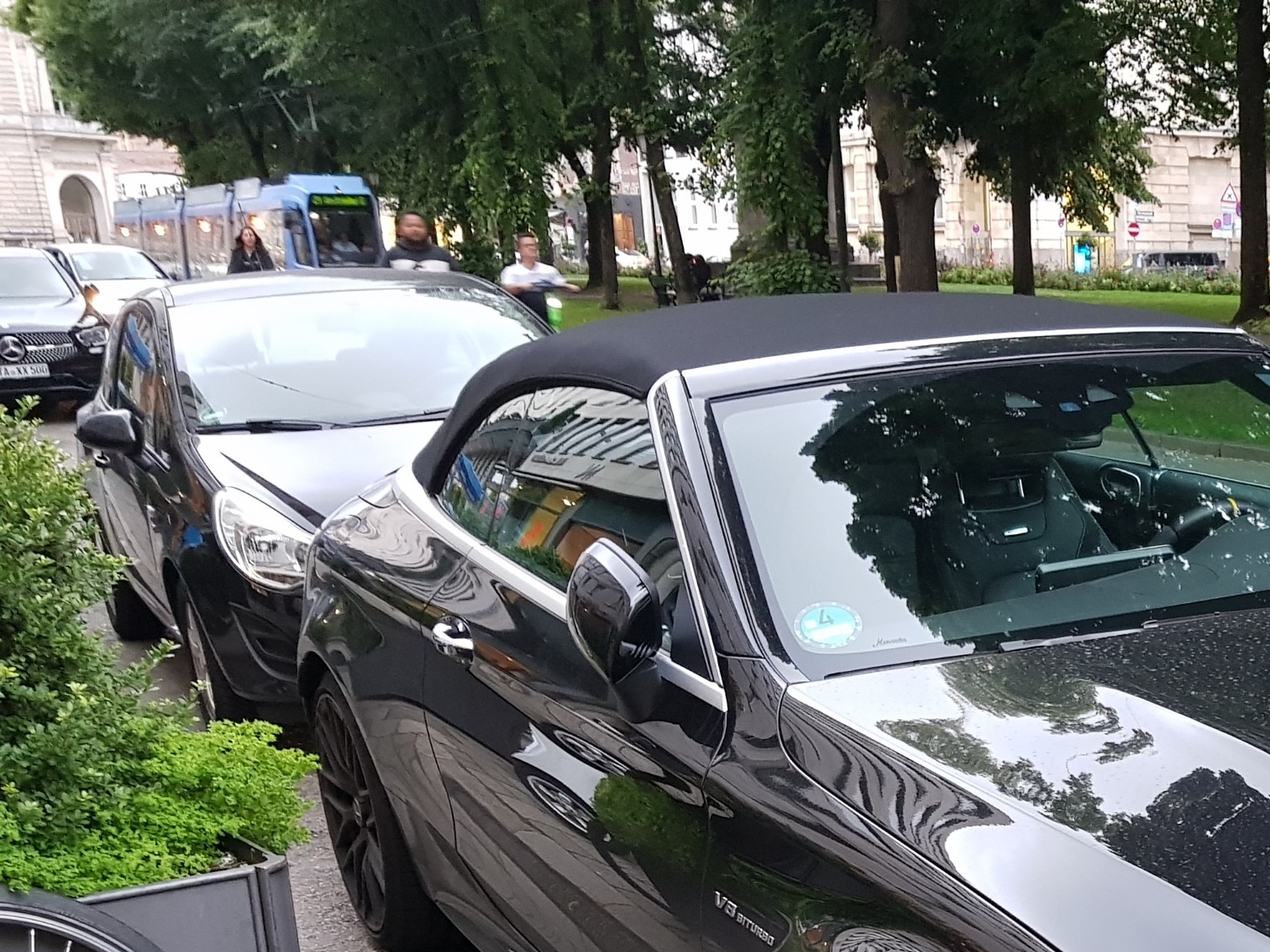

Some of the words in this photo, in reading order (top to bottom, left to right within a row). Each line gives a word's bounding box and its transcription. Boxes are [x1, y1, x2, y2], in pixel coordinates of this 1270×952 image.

[818, 608, 835, 625] 4
[714, 890, 738, 918] V8
[736, 911, 776, 947] BITURBO
